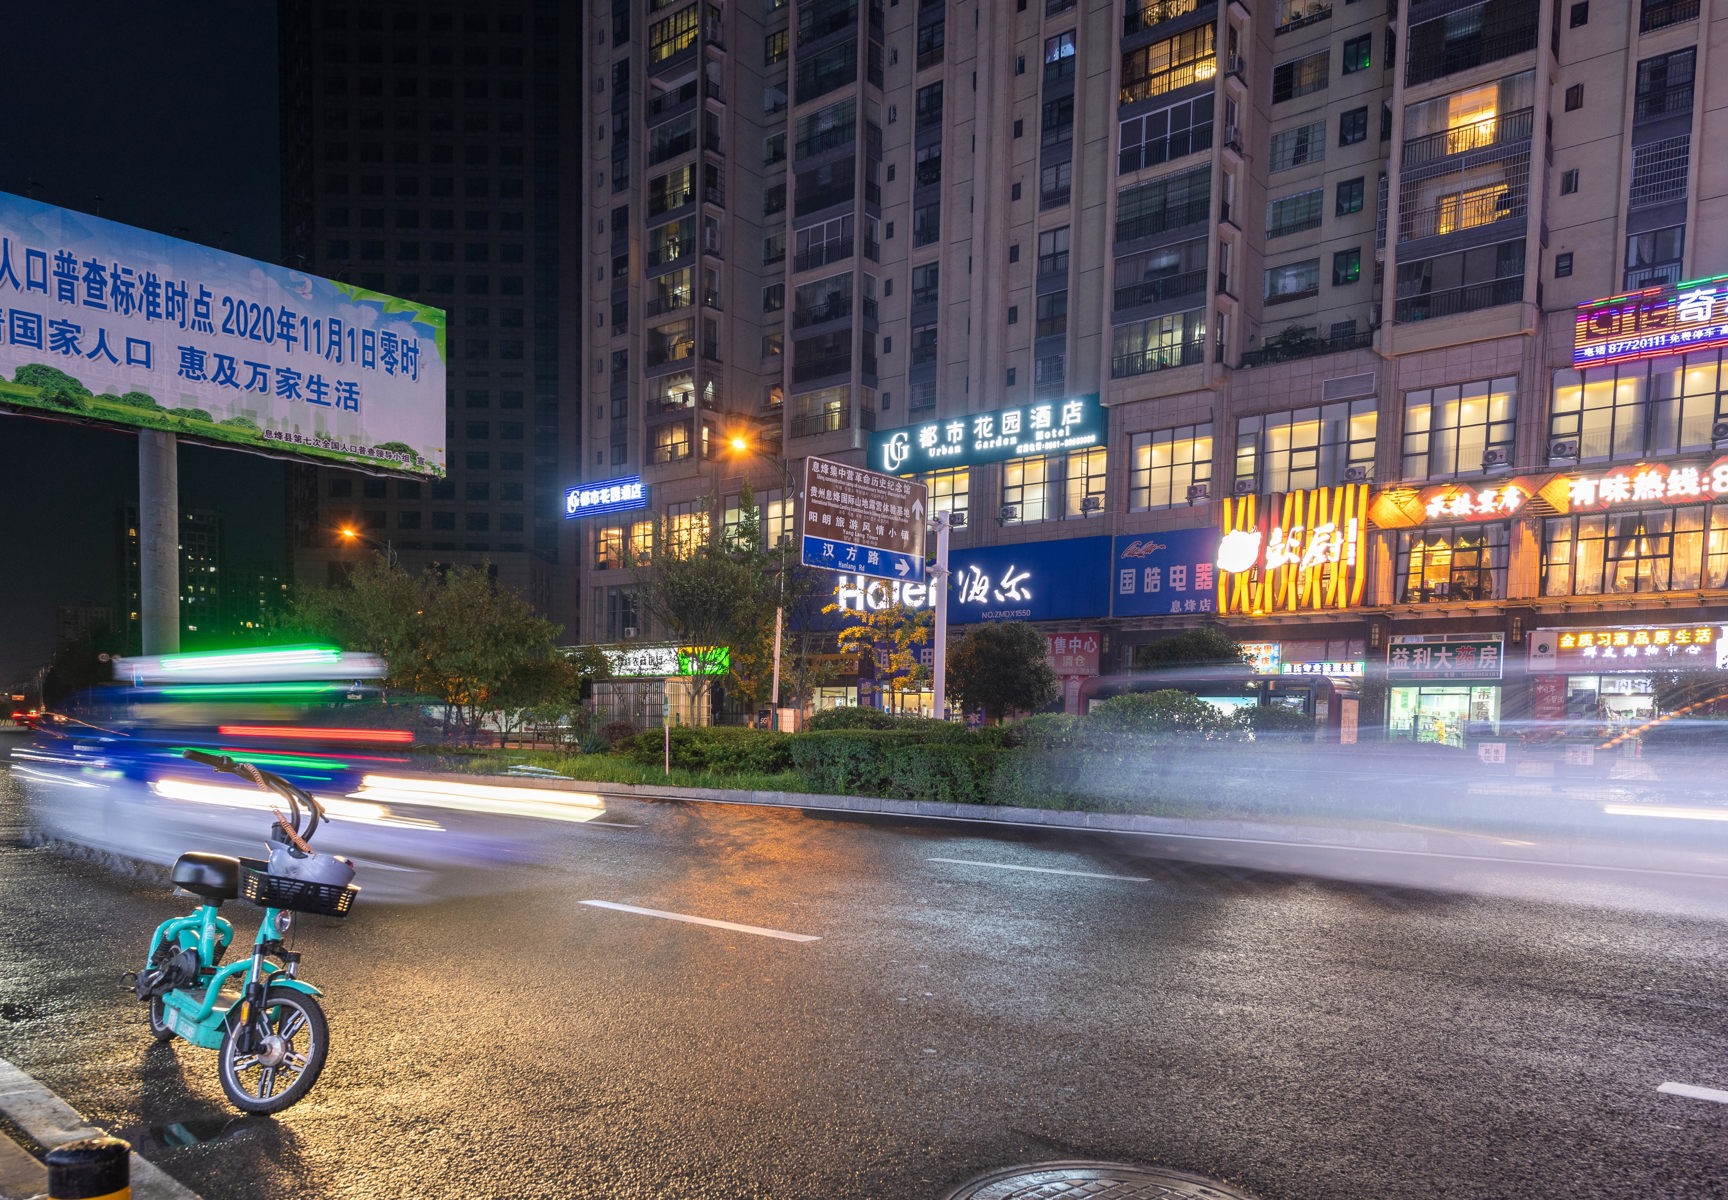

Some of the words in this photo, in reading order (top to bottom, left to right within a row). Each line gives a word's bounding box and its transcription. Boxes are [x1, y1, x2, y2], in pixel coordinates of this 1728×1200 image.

[0, 237, 214, 336] 人口普查标准时点
[222, 296, 420, 383] 2020年11月1日零时
[1608, 335, 1666, 354] 87720111
[0, 308, 152, 369] 国家人口
[178, 344, 360, 413] 惠及万家生活
[919, 400, 1083, 448] 都市花园酒店
[264, 429, 411, 463] 息烽县第七次全国人口普查领导小组
[417, 456, 425, 466] 宣
[928, 444, 961, 457] Urban
[975, 435, 1018, 451] Garden
[811, 461, 911, 496] 息烽集中营革命历史纪念馆
[810, 486, 910, 518] 贵州息烽国际山地露营体验基地
[808, 510, 910, 541] 阳朗旅游风情小镇
[822, 542, 879, 565] 汉方路
[1170, 599, 1211, 613] 息烽店
[1559, 628, 1712, 649] 金质习酒品质生活
[1392, 645, 1498, 670] 益利大药房
